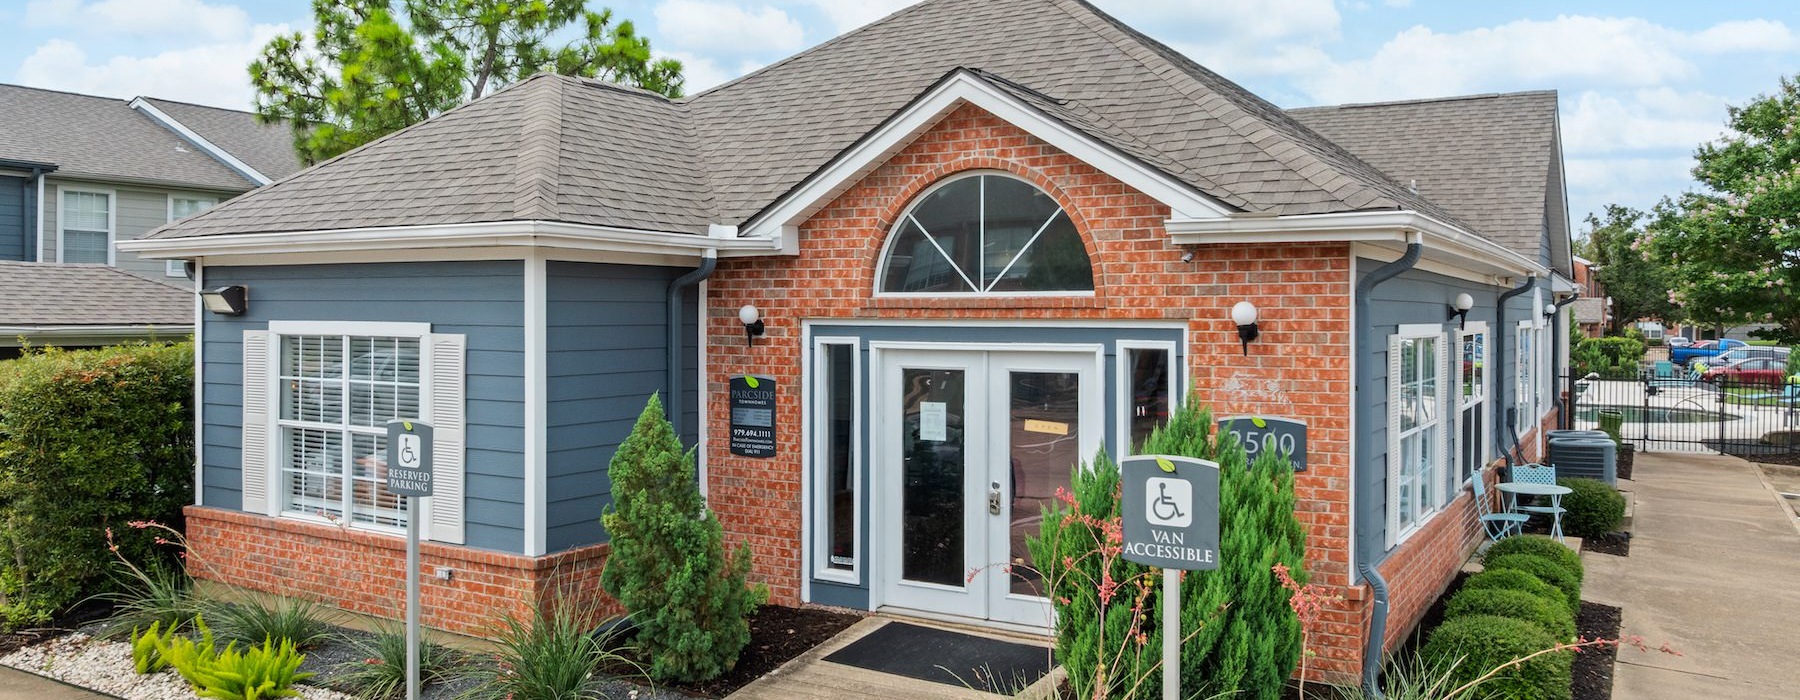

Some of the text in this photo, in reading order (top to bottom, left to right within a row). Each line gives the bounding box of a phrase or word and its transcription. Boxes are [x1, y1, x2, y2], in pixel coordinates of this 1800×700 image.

[732, 390, 774, 400] PARCSIDE
[734, 429, 771, 437] 979.694.1111
[1228, 430, 1296, 457] 2500
[388, 469, 430, 482] RESERVED
[390, 479, 428, 492] PARKING
[1151, 529, 1185, 545] VAN
[1124, 541, 1214, 563] ACCESSIBLE
